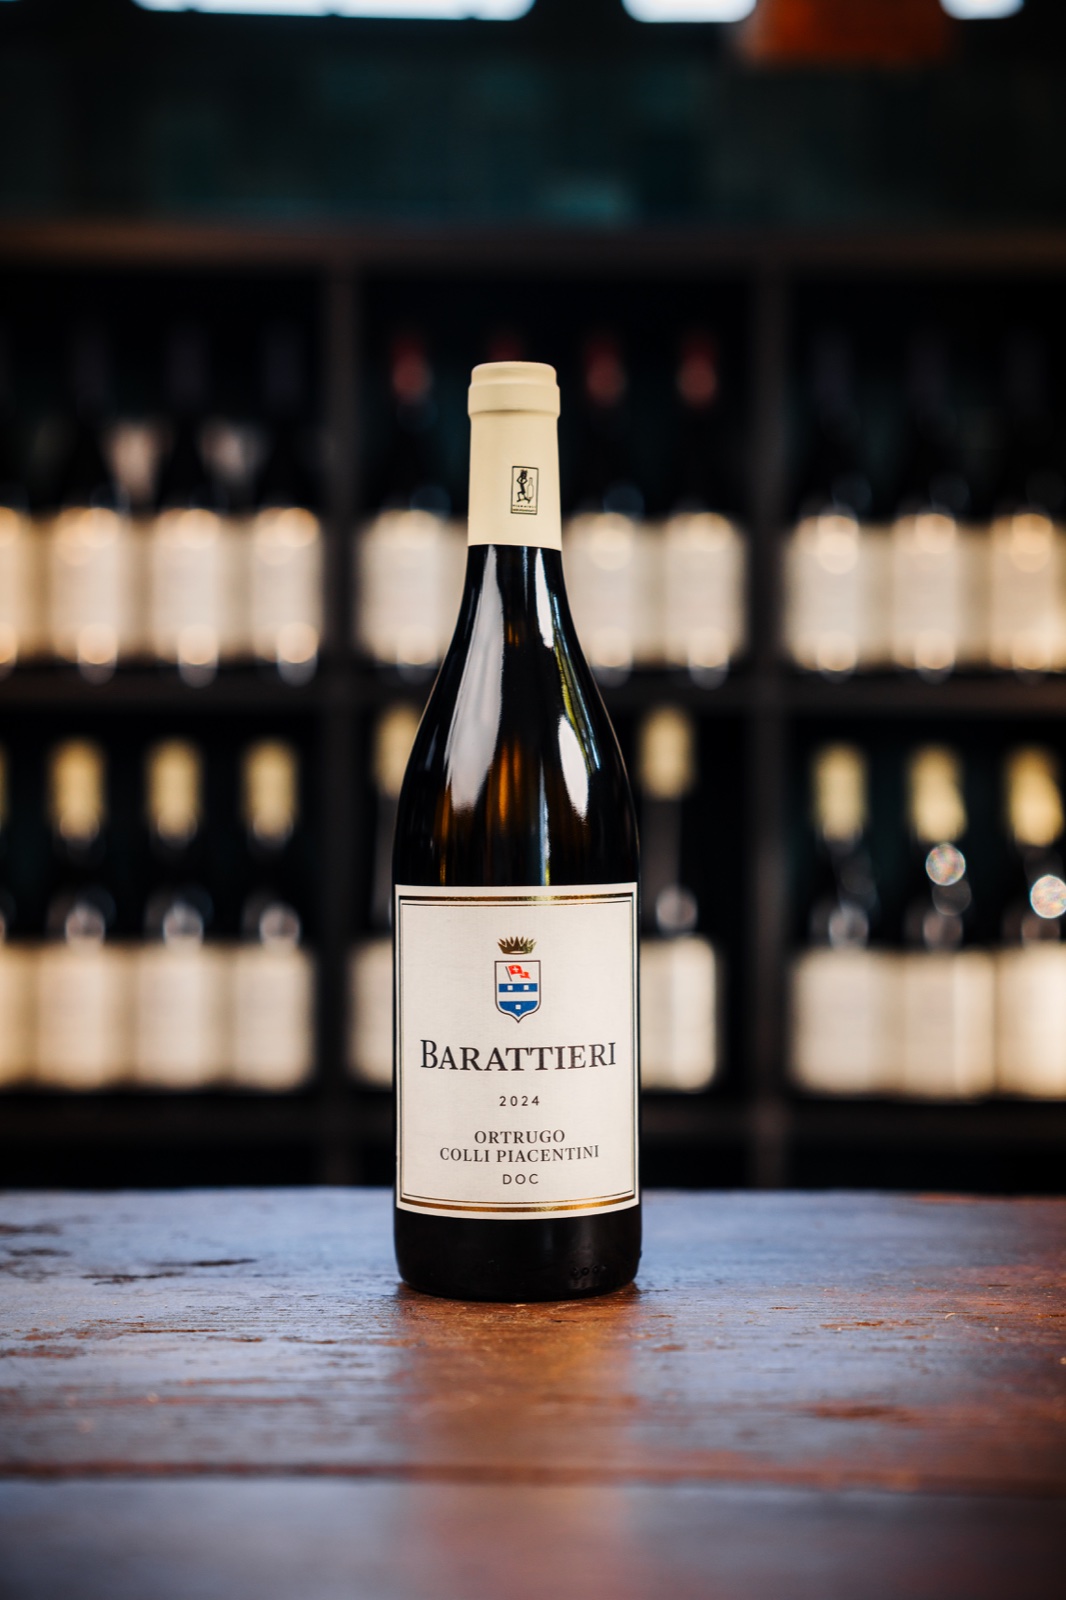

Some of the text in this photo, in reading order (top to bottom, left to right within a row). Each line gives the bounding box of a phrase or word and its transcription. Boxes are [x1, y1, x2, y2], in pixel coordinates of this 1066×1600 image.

[420, 1040, 617, 1072] BARATTIERI
[499, 1095, 540, 1107] 2024
[474, 1129, 566, 1145] ORTRUGO
[439, 1145, 600, 1163] COLLI PIACENTINI
[502, 1173, 539, 1185] DOC
